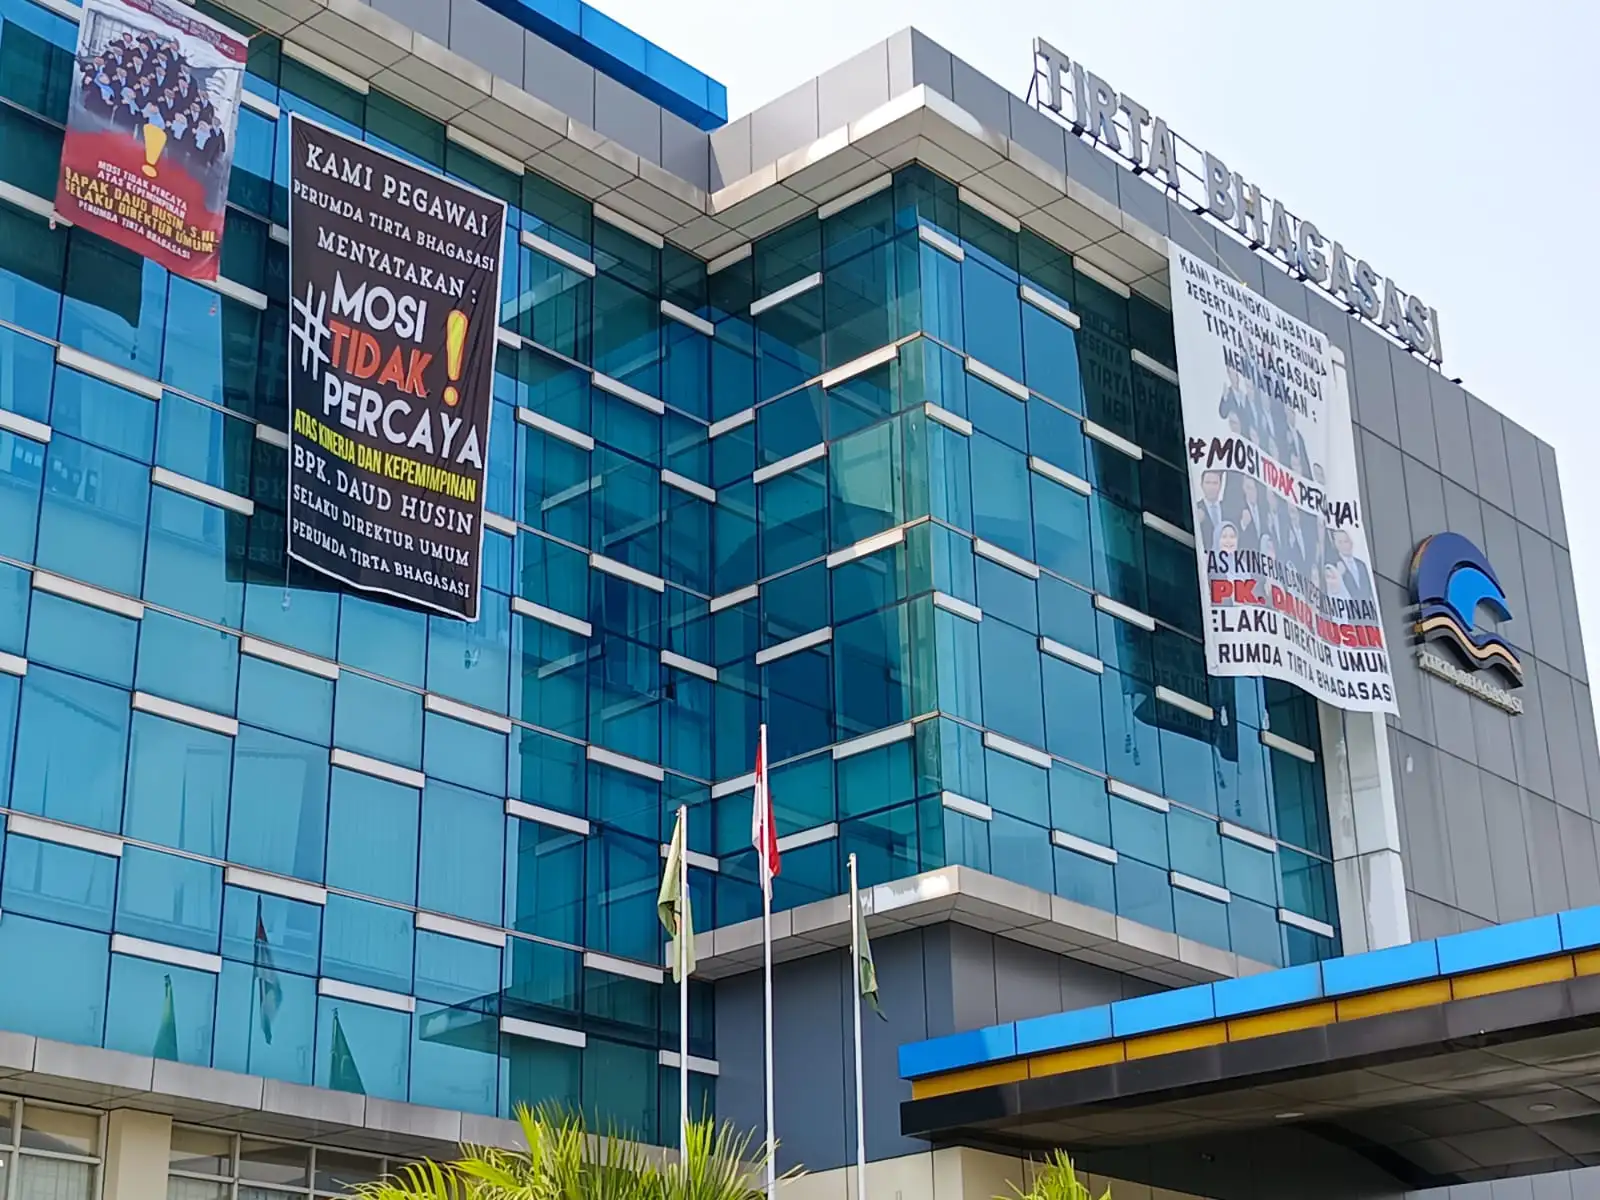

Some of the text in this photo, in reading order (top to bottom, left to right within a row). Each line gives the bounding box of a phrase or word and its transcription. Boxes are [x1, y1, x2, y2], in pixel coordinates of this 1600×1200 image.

[65, 166, 109, 196] BAPAK
[114, 189, 147, 211] DAUD
[65, 178, 113, 210] SELAKU
[118, 202, 172, 237] DIREKTUR
[175, 231, 213, 253] UMUM
[98, 171, 124, 188] ATAS
[98, 161, 187, 210] MOSI TIDAK PERCAYA
[305, 143, 489, 239] KAMI PEGAWAI
[1035, 36, 1443, 364] TIRTA BHAGASASI
[78, 200, 118, 224] PERUMDA
[121, 217, 144, 236] TIRTA
[293, 179, 364, 224] PERUMDA
[368, 211, 412, 243] TIRTA
[416, 229, 496, 272] BHAGASASI
[317, 226, 465, 299] MENYATAKAN
[331, 270, 428, 344] MOSI
[1179, 254, 1323, 355] KAMI PEMANGKU JABATAN
[1203, 310, 1246, 352] TIRTA
[328, 319, 434, 399] TIDAK
[294, 408, 318, 444] ATAS
[318, 422, 355, 464] KINERJA
[357, 447, 381, 474] DAN
[384, 453, 477, 503] KEPEMIMPINAN
[322, 372, 483, 470] PERCAYA
[293, 444, 332, 485] BPK.
[336, 469, 393, 512] DAUD
[400, 495, 474, 536] HUSIN
[1188, 437, 1261, 478] #MOSI
[1261, 456, 1299, 504] TIDAK
[292, 518, 347, 559] PERUMDA
[350, 546, 391, 573] TIRTA
[394, 561, 471, 599] BHAGASASI
[293, 483, 470, 567] SELAKU DIREKTUR UMUM
[1234, 549, 1285, 585] KINERJA
[1218, 643, 1283, 668] RUMDA
[1287, 650, 1315, 683] TIRTA
[1283, 617, 1334, 668] DIREKTUR
